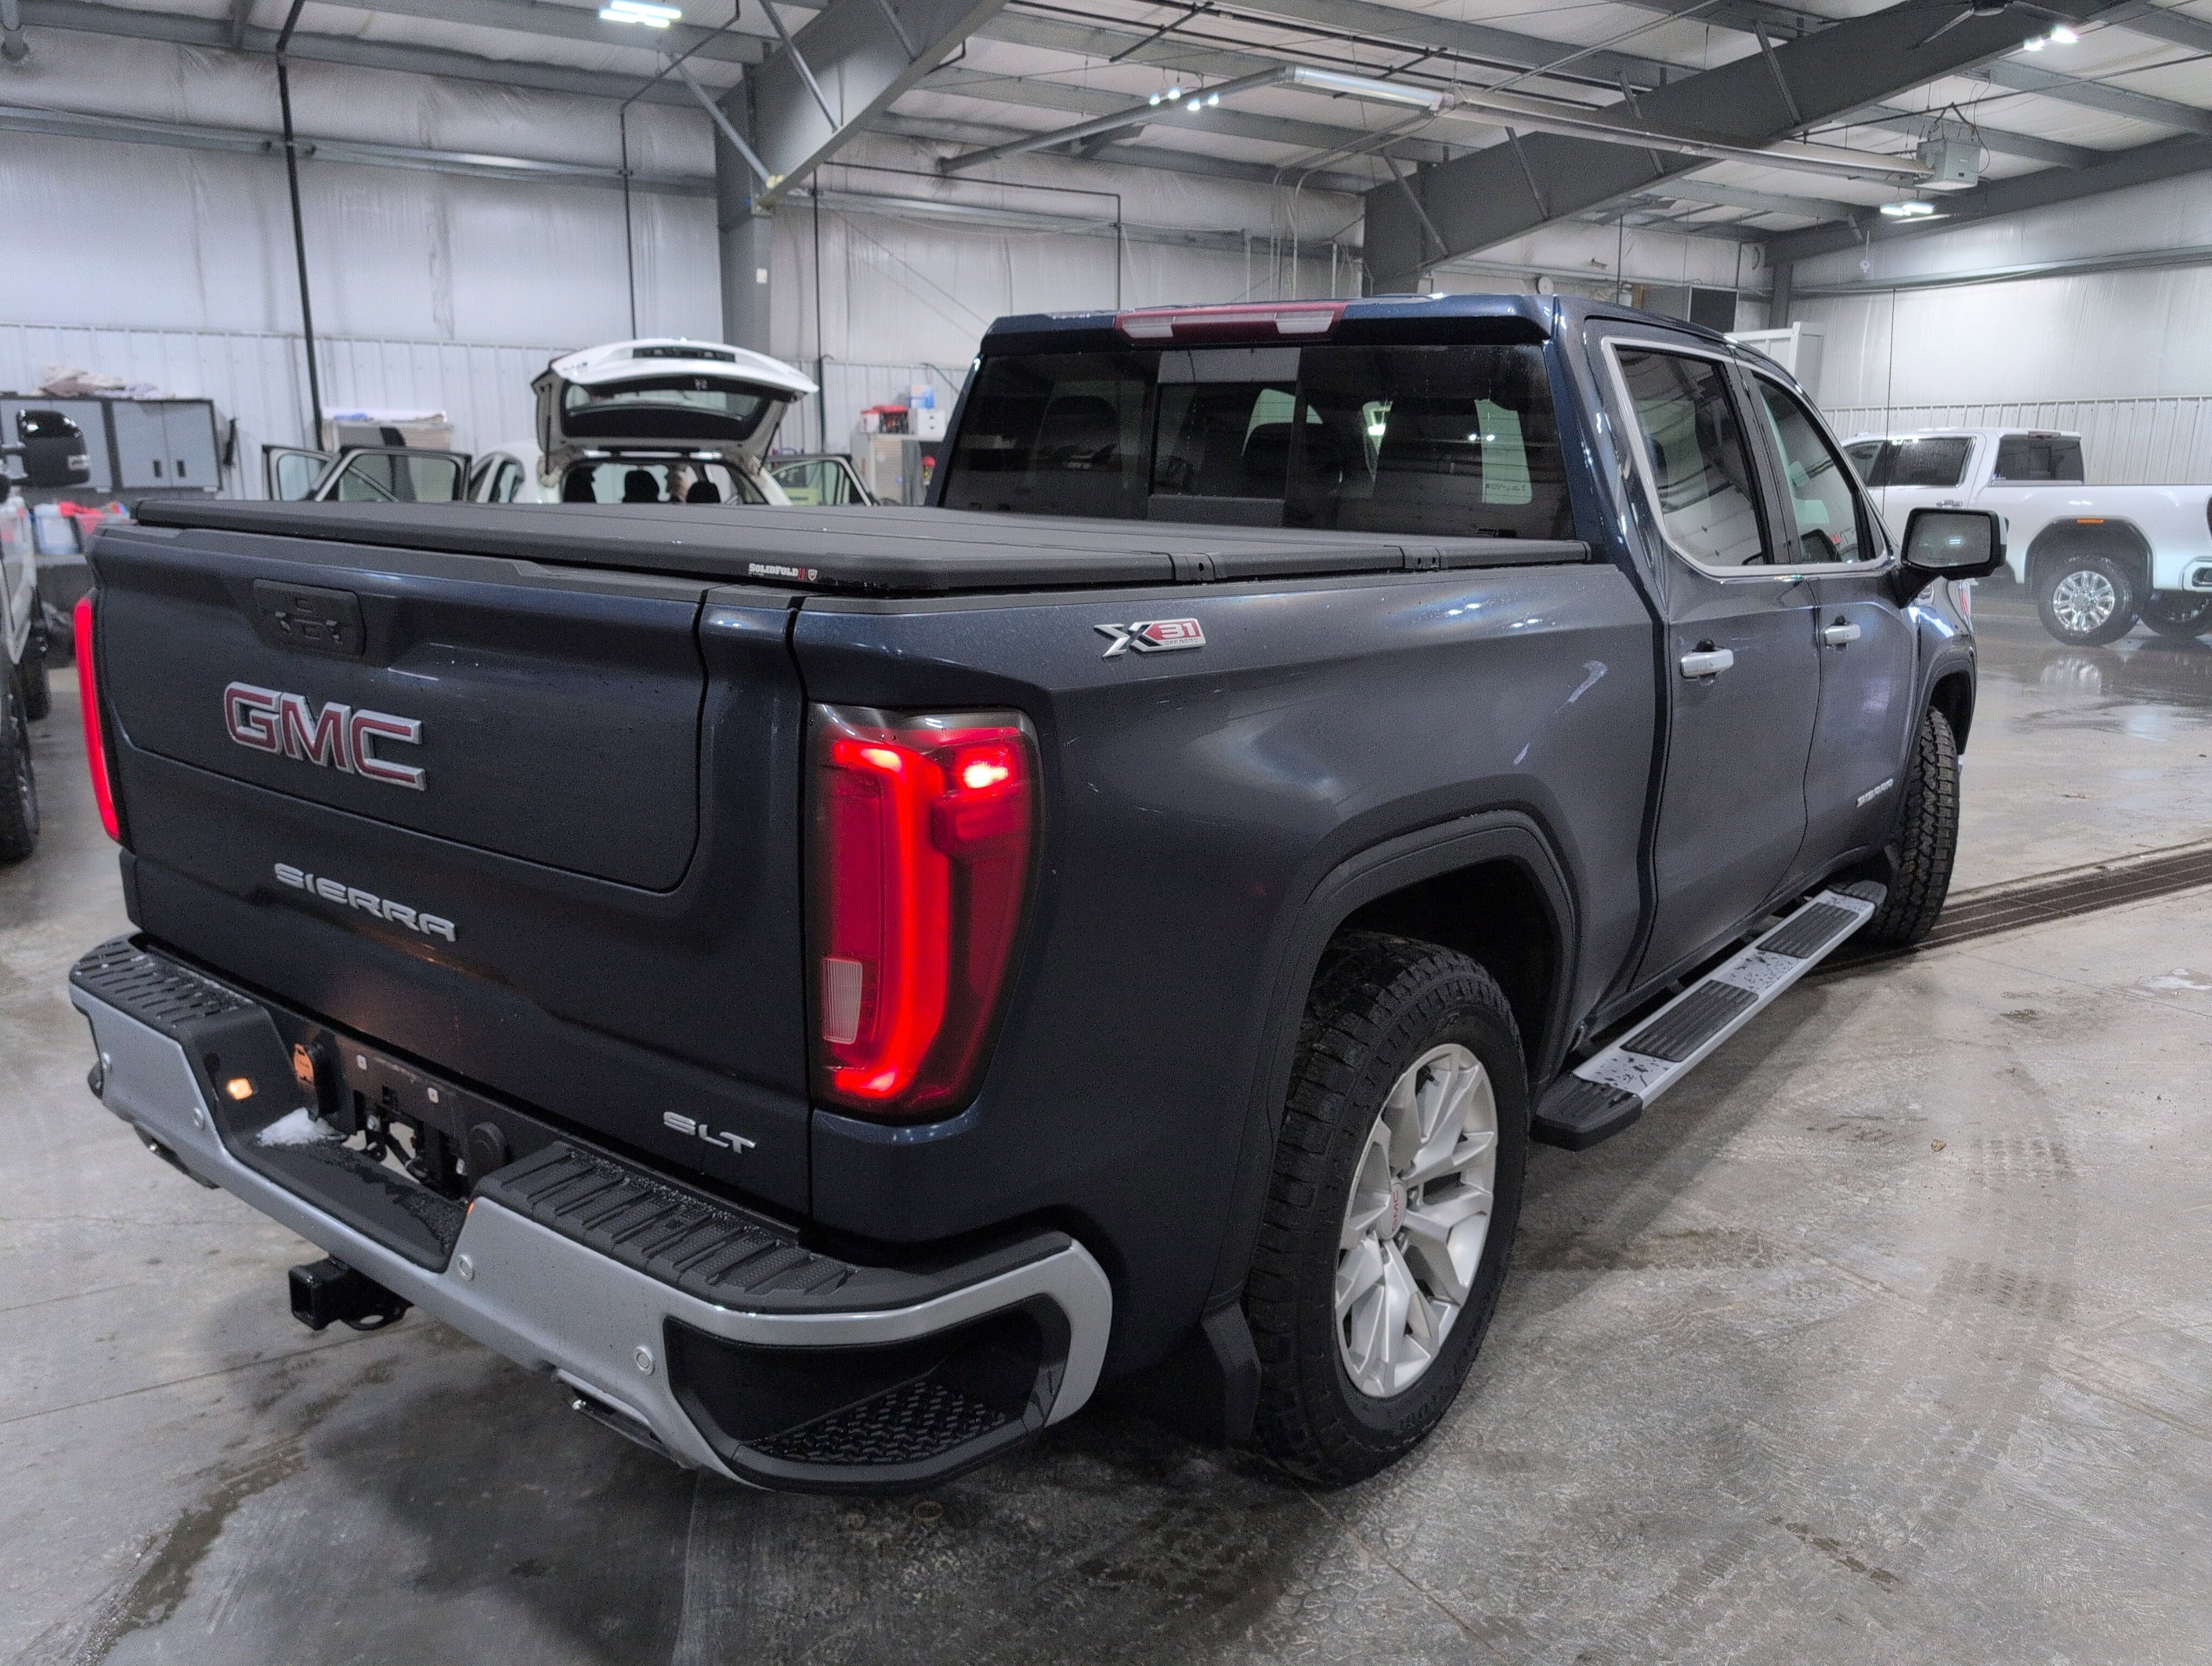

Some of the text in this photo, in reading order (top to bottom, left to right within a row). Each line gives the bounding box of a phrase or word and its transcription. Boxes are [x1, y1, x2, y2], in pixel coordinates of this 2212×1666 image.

[749, 563, 799, 576] SOLIDFOLD
[224, 681, 427, 791] GMC
[274, 862, 456, 942] SIERRA
[663, 1111, 756, 1154] SLT
